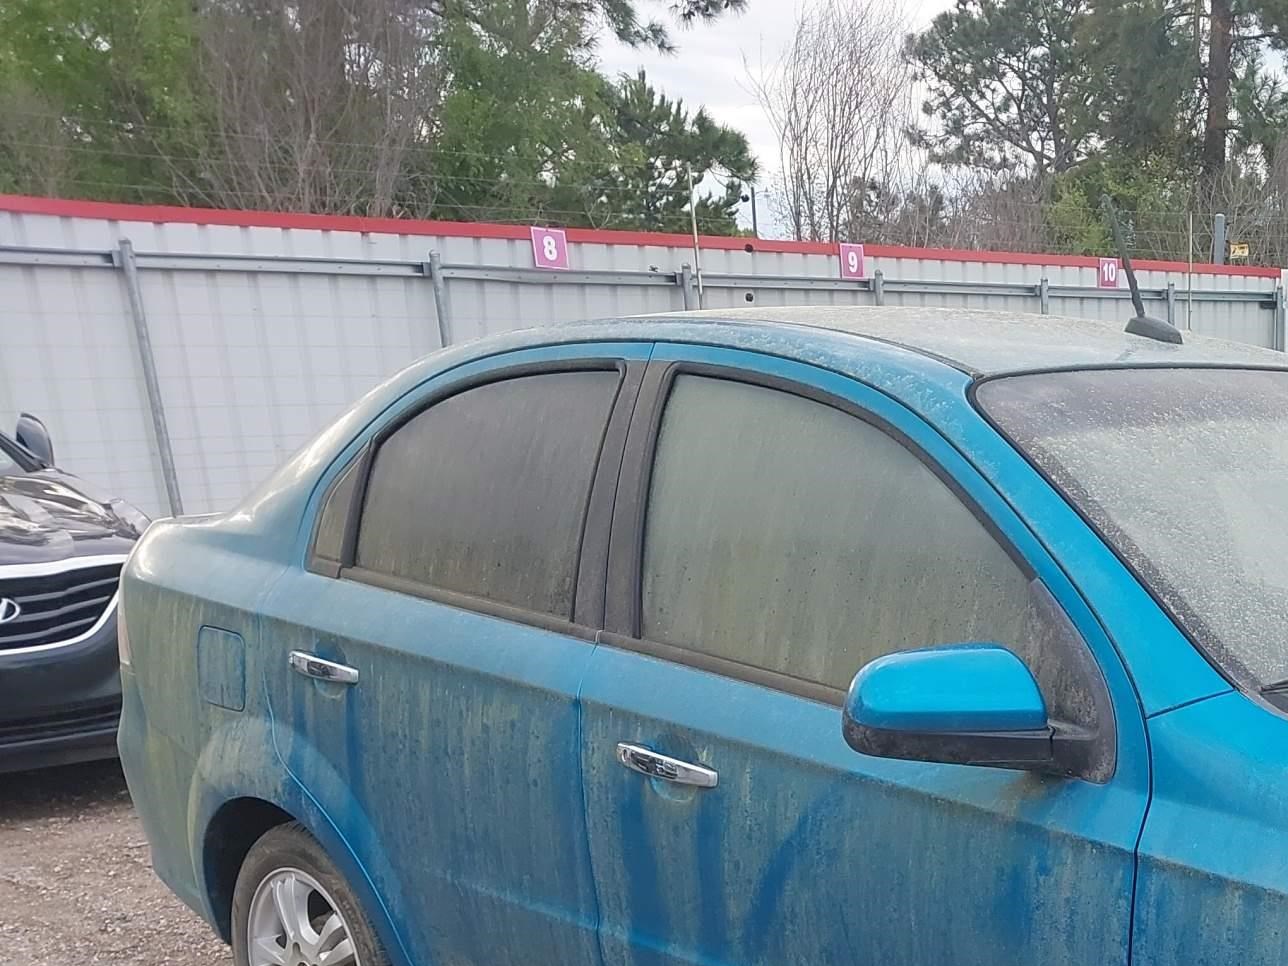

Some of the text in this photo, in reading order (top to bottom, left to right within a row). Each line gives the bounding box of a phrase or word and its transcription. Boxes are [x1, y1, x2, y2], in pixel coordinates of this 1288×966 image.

[543, 235, 558, 261] 8
[848, 251, 858, 273] 9
[1103, 262, 1116, 282] 10
